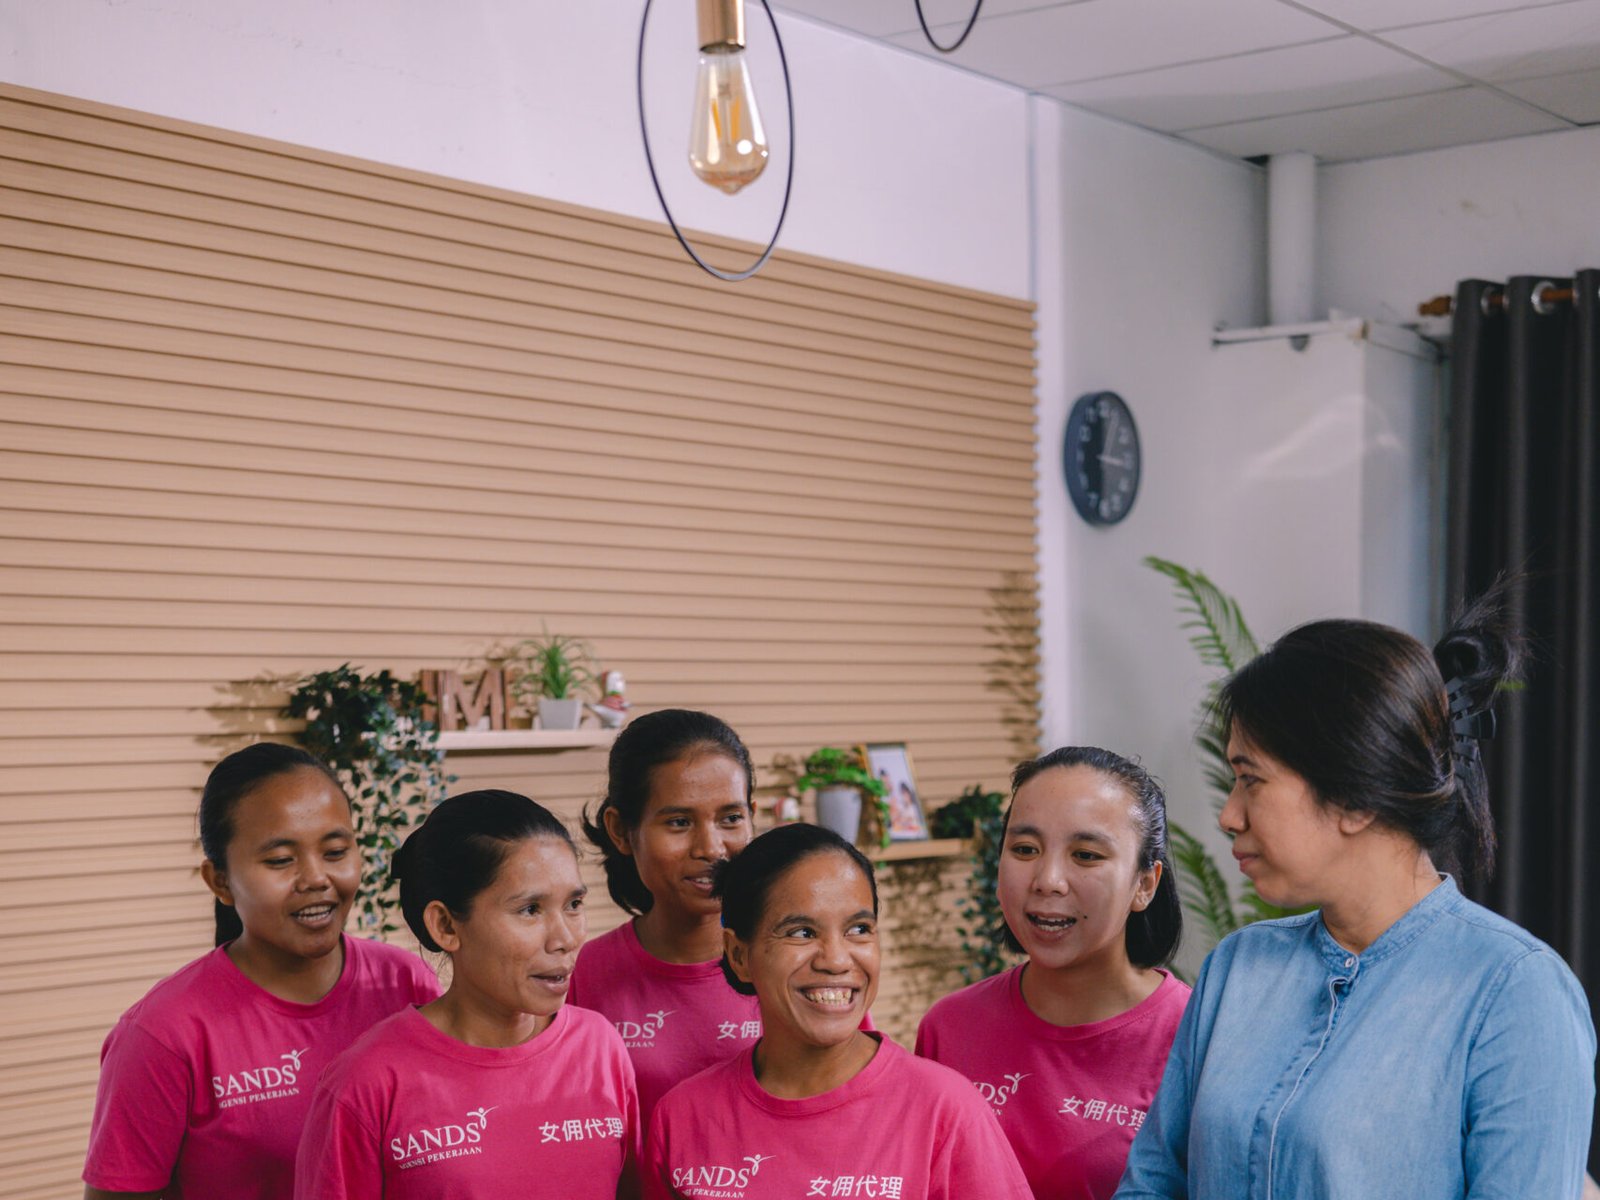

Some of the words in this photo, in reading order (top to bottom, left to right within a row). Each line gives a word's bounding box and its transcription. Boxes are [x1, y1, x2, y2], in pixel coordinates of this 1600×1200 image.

[717, 1020, 761, 1040] 女佣
[212, 1064, 297, 1098] SANDS
[249, 1087, 300, 1103] PEKERJAAN
[973, 1081, 1009, 1105] DS
[390, 1121, 482, 1161] SANDS
[537, 1117, 624, 1144] 女佣代理
[427, 1146, 483, 1163] PEKERJAAN
[672, 1166, 750, 1189] SANDS
[806, 1175, 903, 1200] 女佣代理
[692, 1187, 745, 1199] PEKERJAAN
